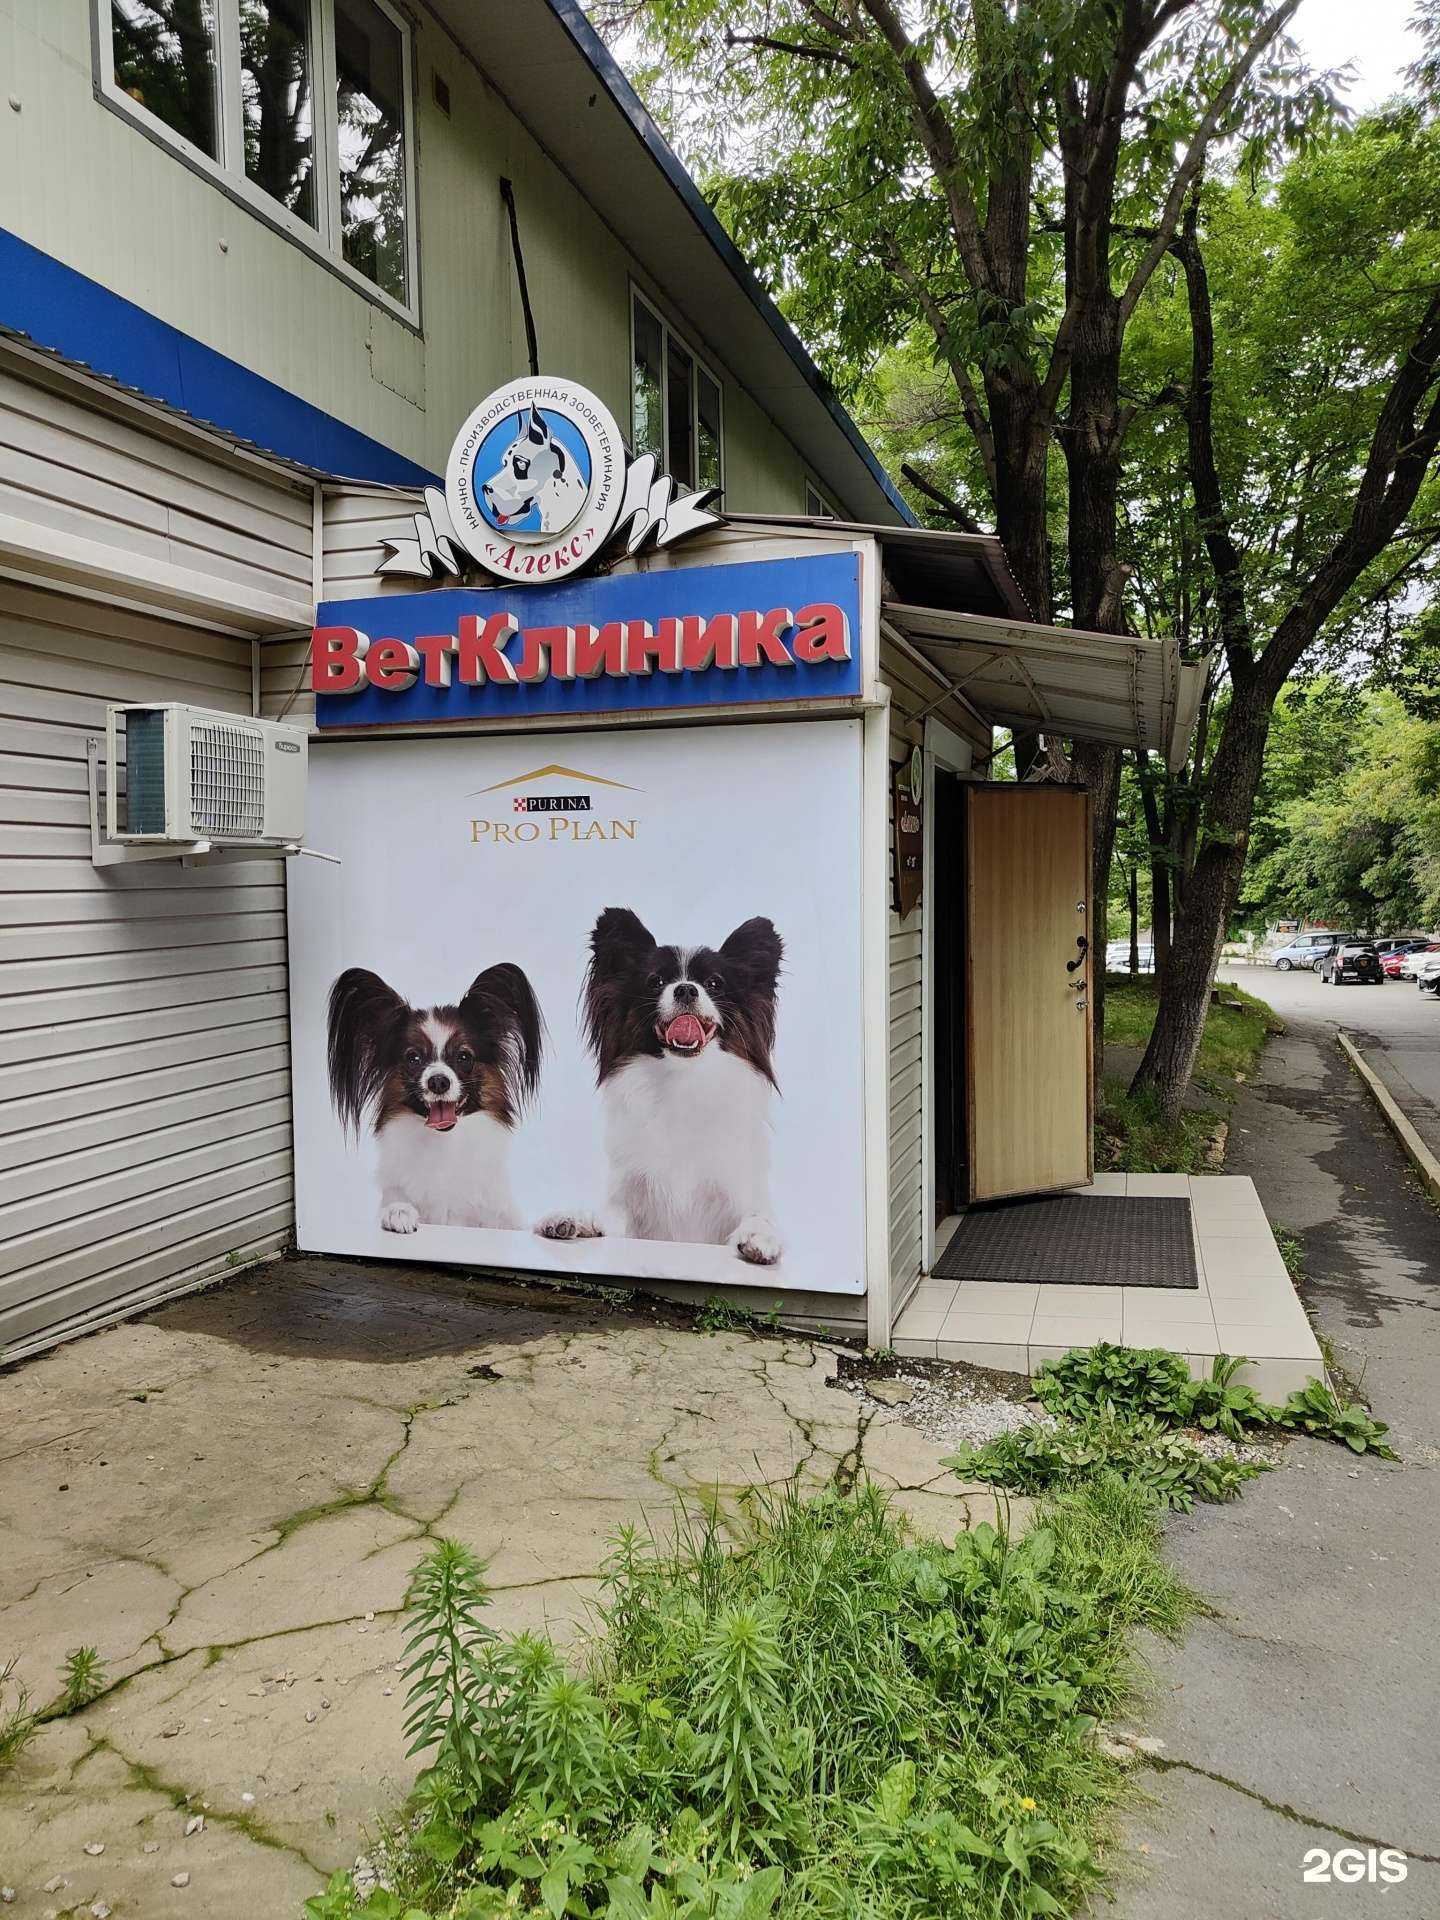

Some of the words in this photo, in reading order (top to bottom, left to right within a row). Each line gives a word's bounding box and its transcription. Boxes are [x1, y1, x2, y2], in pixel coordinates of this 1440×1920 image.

[569, 397, 613, 512] ЗООВЕТЕРИНАРИЯ
[484, 527, 595, 575] «Алекс»
[311, 602, 852, 695] ВетКлиника
[528, 797, 589, 812] PURINA
[469, 819, 540, 844] PRO
[548, 817, 640, 841] PLAN
